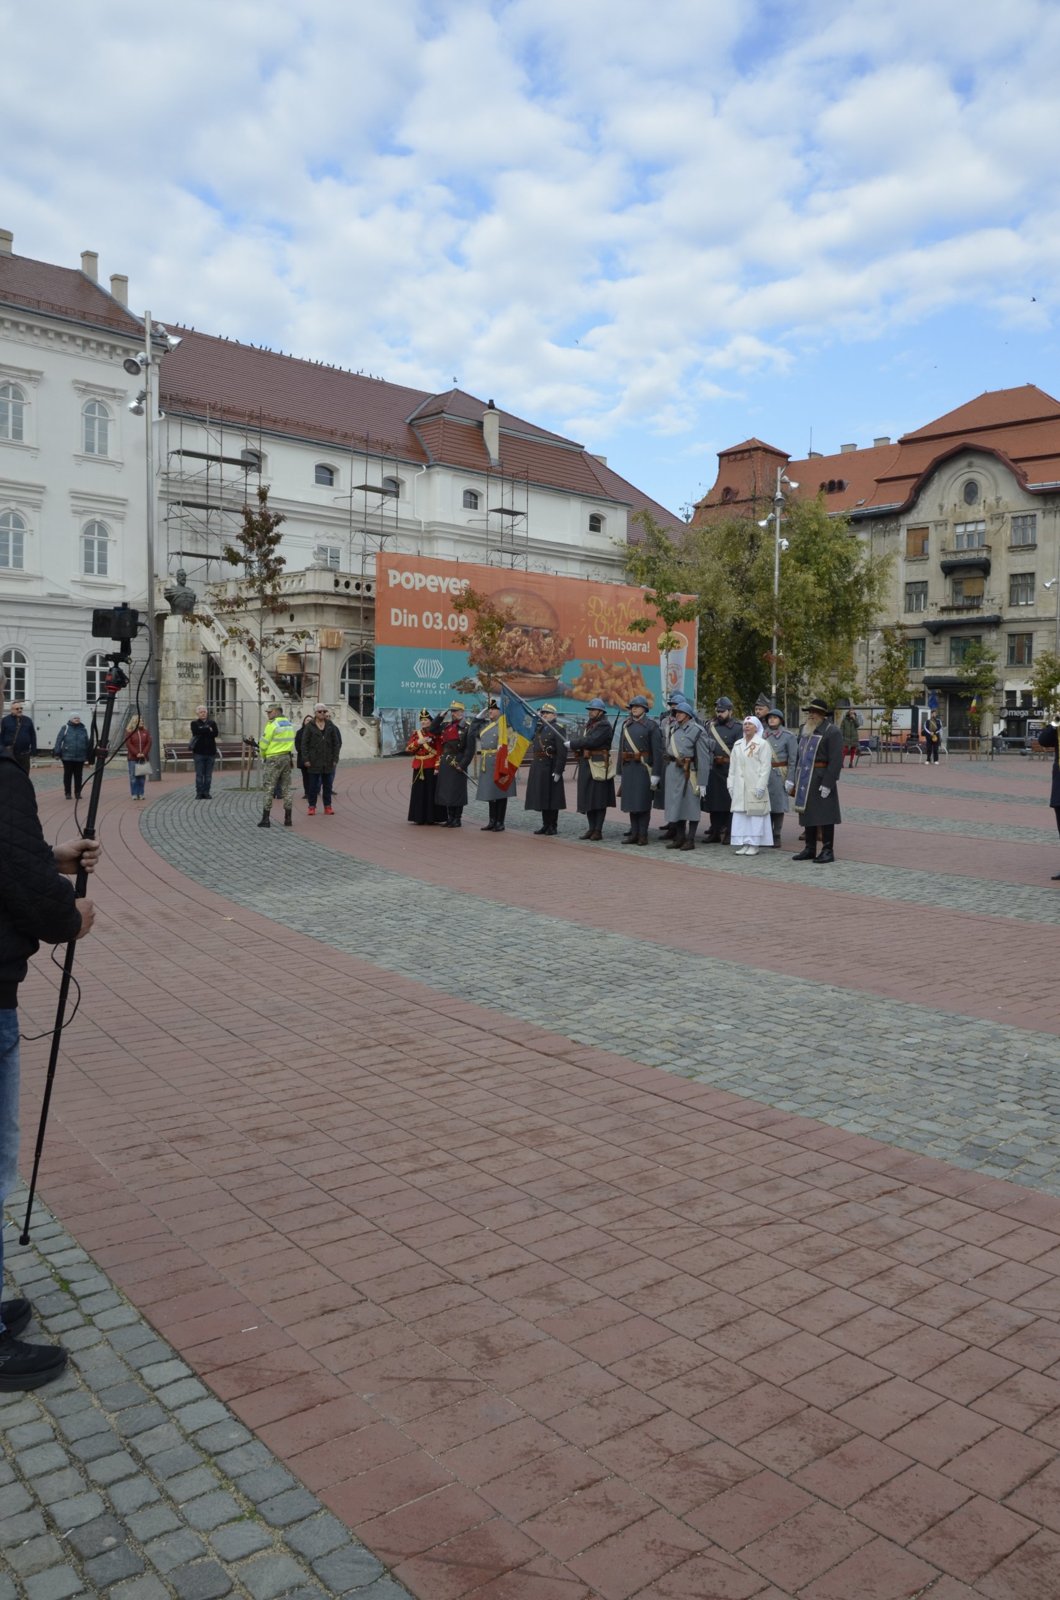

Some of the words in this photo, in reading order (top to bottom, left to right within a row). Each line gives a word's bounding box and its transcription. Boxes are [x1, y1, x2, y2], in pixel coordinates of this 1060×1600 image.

[390, 607, 418, 628] Din
[422, 611, 469, 632] 03.09
[588, 634, 598, 648] în
[599, 636, 650, 654] Timișoara!
[400, 680, 437, 689] SHOPPING
